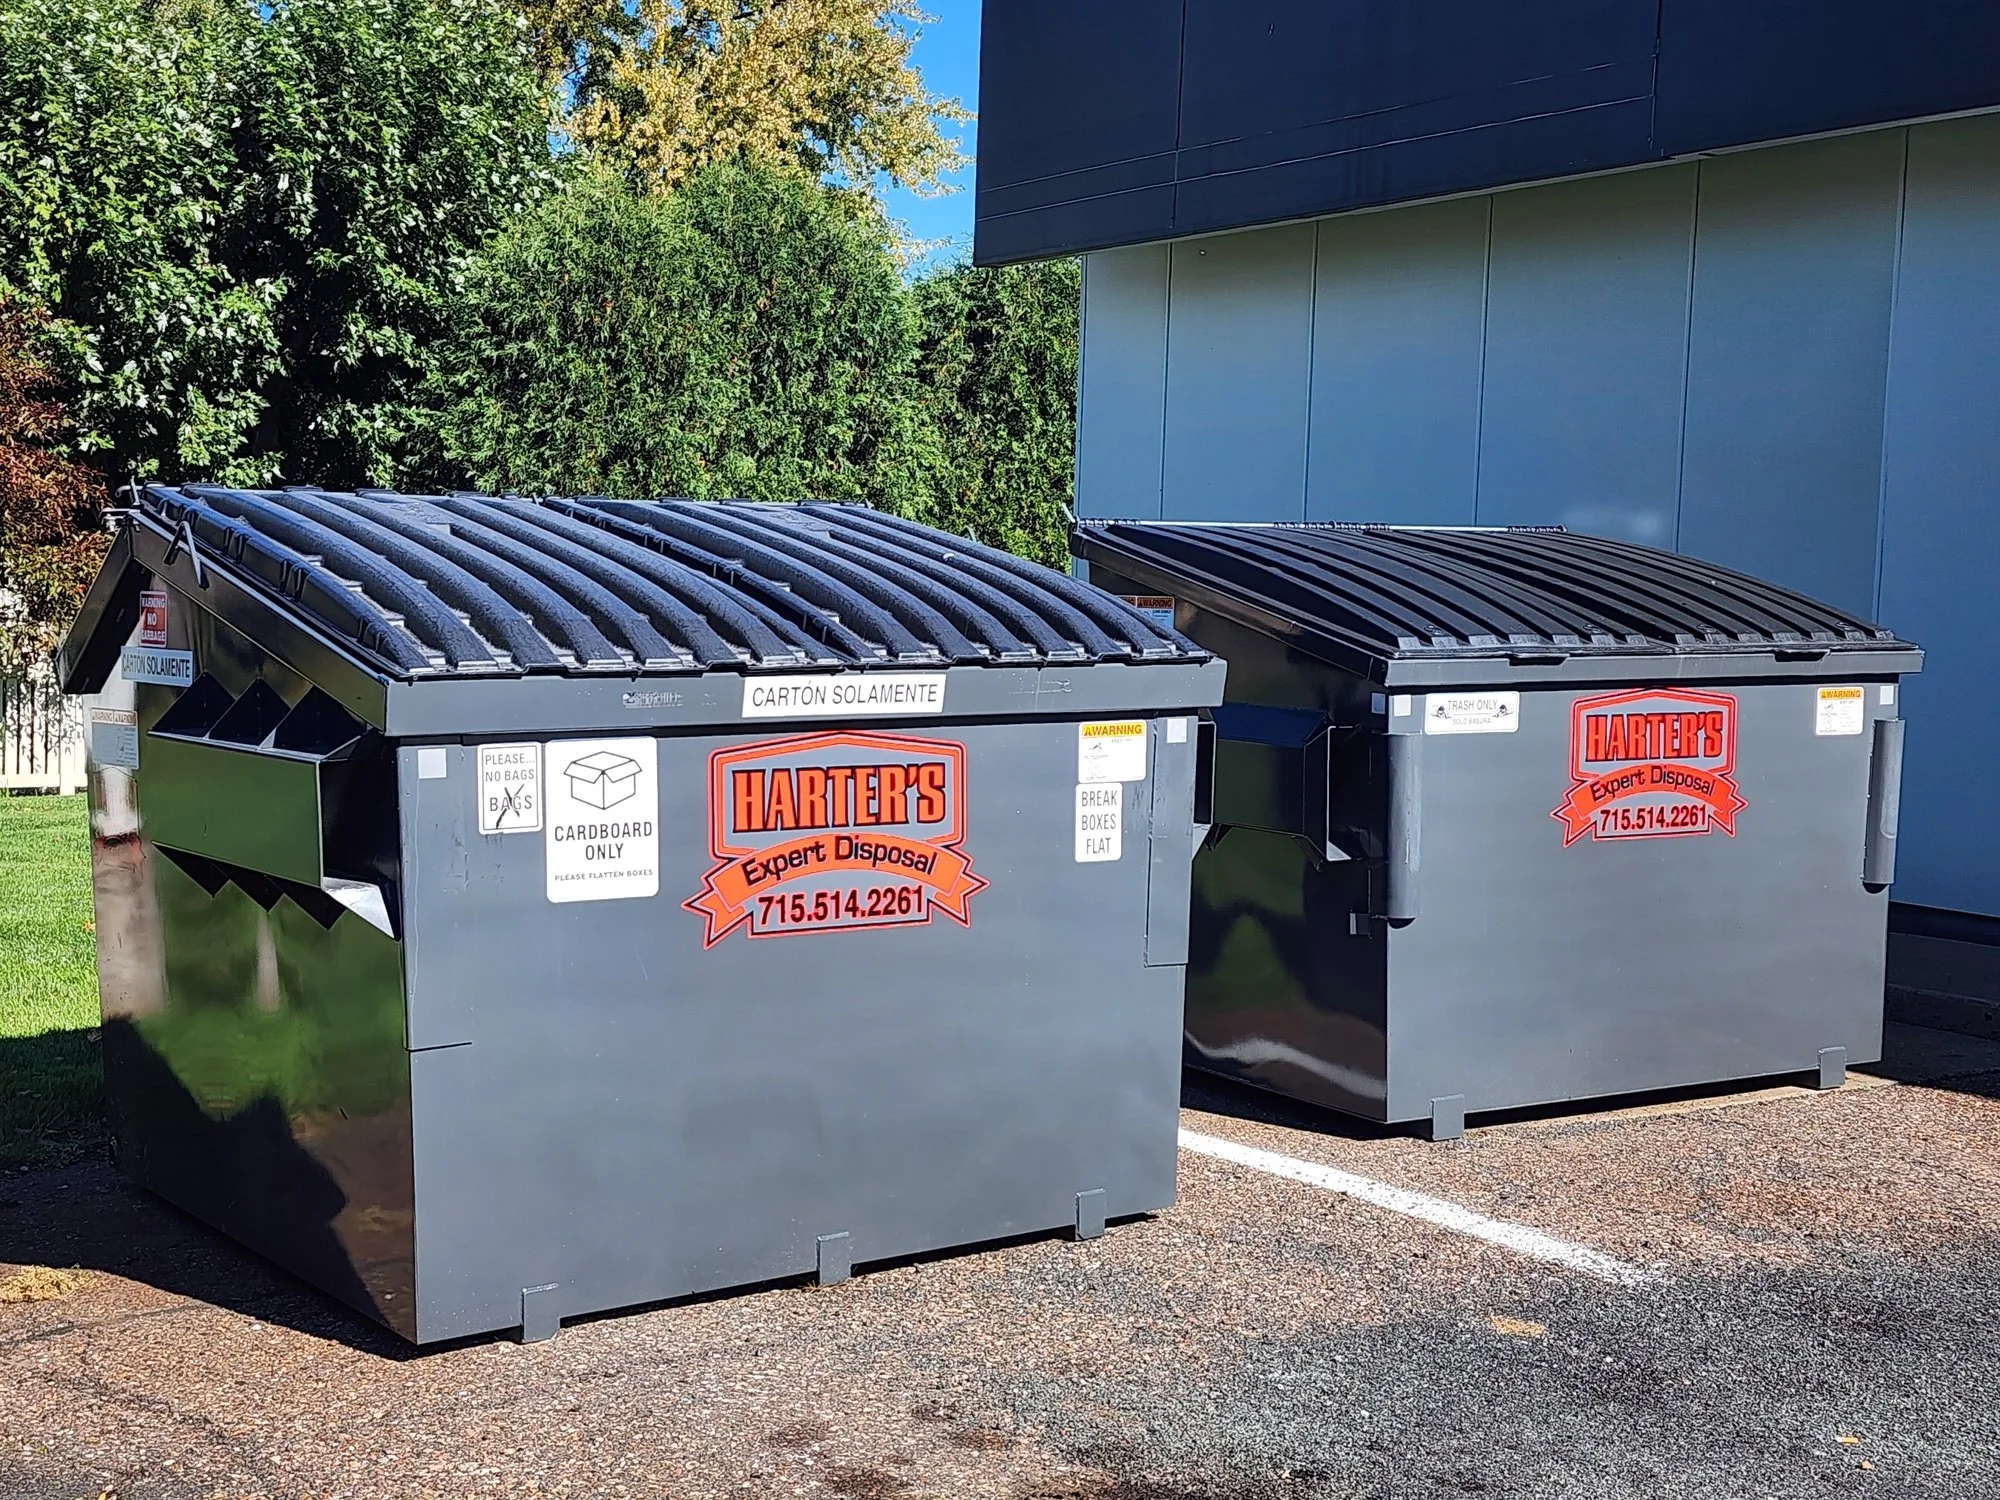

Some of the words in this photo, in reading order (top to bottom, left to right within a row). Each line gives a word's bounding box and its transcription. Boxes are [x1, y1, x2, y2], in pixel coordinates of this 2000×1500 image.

[147, 612, 157, 626] NO
[146, 655, 190, 679] SOLAMENTE
[752, 680, 826, 707] CARTÓN
[832, 683, 938, 705] SOLAMENTE
[1826, 690, 1861, 698] WARNING
[1448, 700, 1475, 711] TRASH
[1476, 699, 1498, 710] ONLY
[1091, 724, 1143, 736] WARNING
[1585, 711, 1723, 762] HARTER'S
[485, 753, 535, 765] PLEASE...
[485, 771, 501, 782] NO
[504, 769, 535, 781] BAGS
[1590, 767, 1646, 803] Expert
[1650, 765, 1717, 797] Disposal
[489, 795, 533, 812] BAGS
[732, 763, 945, 833] HARTER'S
[1081, 790, 1118, 807] BREAK
[1081, 813, 1117, 831] BOXES
[1600, 804, 1708, 832] 715.514.2261
[554, 821, 653, 842] CARDBOARD
[585, 843, 624, 861] ONLY
[1086, 837, 1112, 854] FLAT
[740, 841, 827, 887] Expert
[834, 834, 938, 876] Disposal
[554, 873, 587, 881] PLEASE
[588, 871, 625, 879] FLATTEN
[626, 869, 654, 877] BOXES
[757, 884, 924, 926] 715.514.2261
